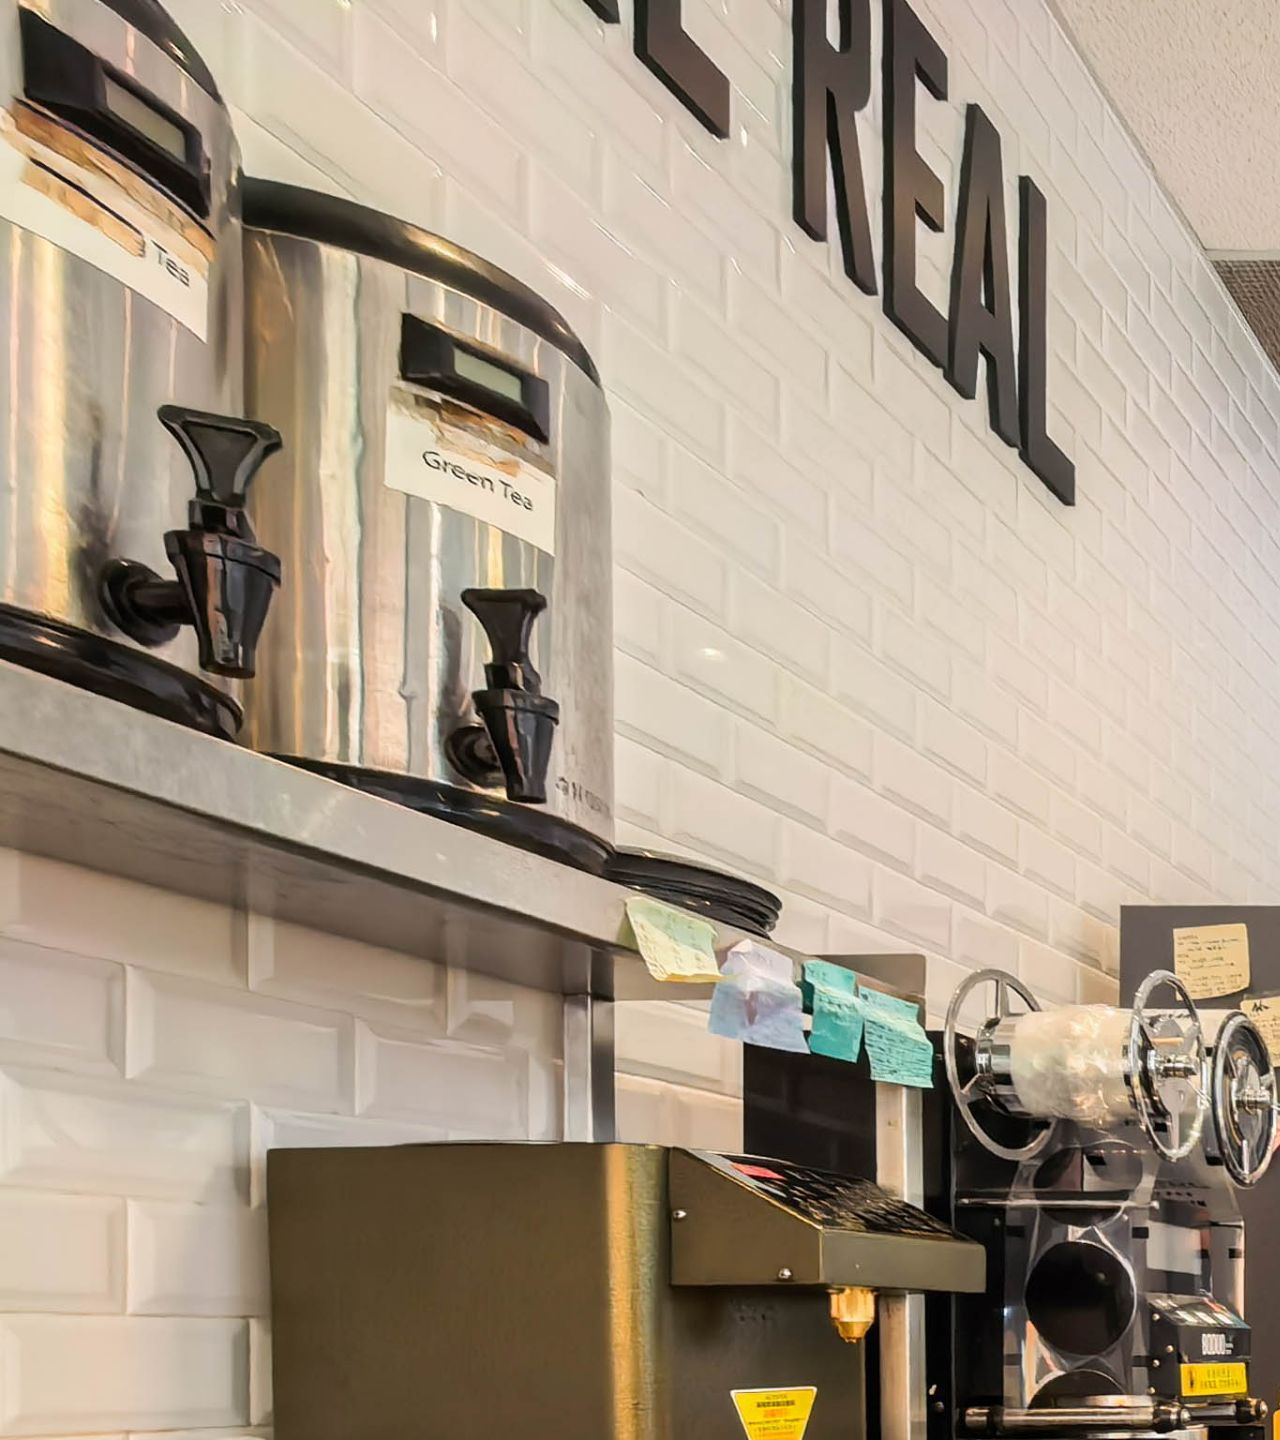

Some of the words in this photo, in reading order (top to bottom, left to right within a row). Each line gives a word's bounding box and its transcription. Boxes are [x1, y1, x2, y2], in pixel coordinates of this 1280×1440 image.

[151, 239, 191, 287] Tea
[792, 0, 1076, 507] REAL
[421, 449, 496, 494] Green
[498, 478, 536, 512] Tea
